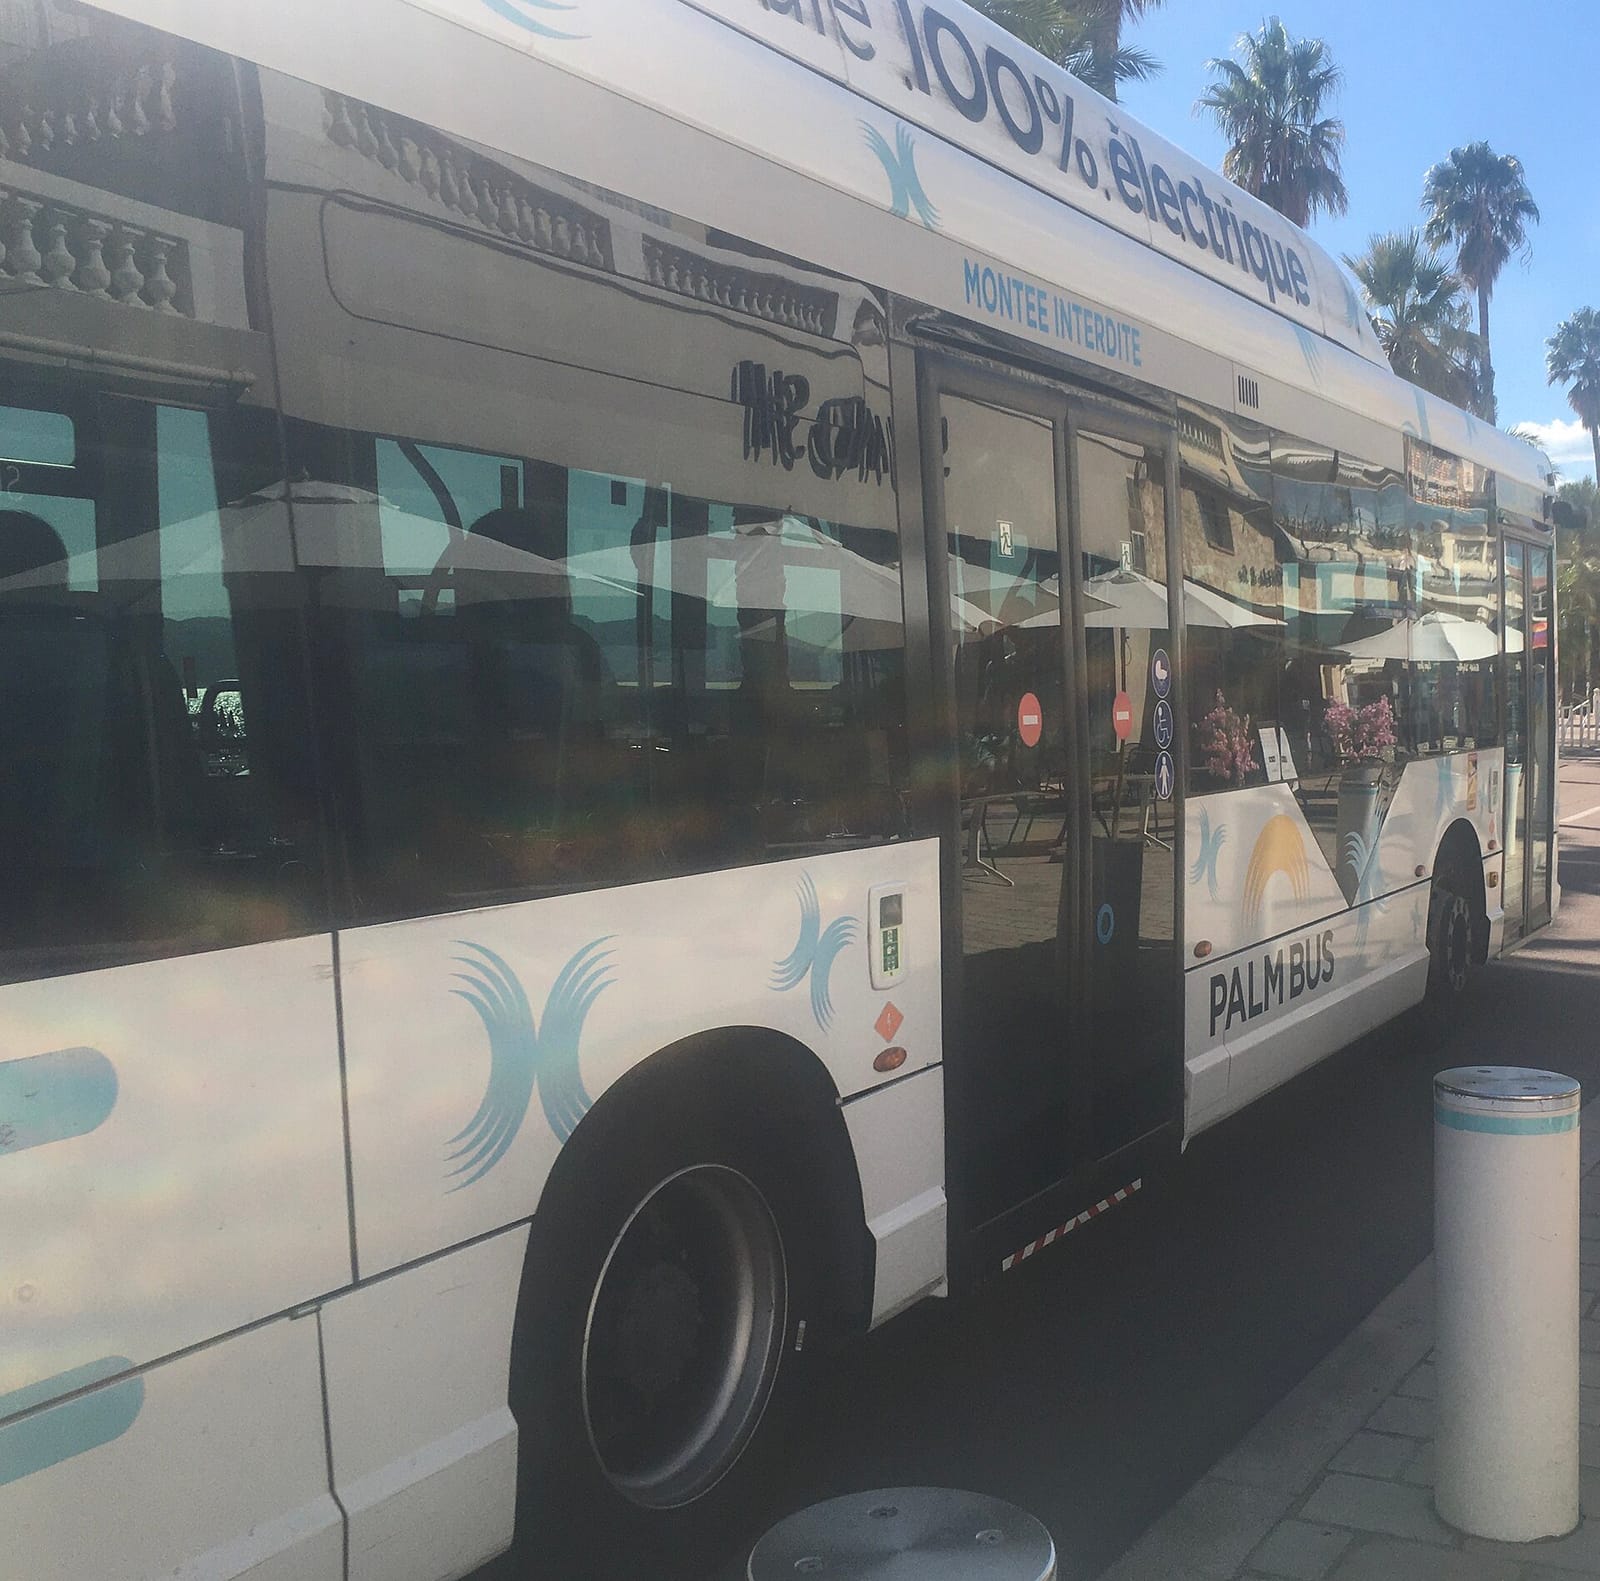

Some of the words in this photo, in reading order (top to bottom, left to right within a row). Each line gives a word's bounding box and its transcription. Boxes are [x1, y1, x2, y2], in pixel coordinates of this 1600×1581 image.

[897, 0, 1099, 190] 100%
[1106, 117, 1311, 307] électrique
[963, 258, 1050, 334] MONTEE
[1053, 295, 1142, 367] INTERDITE
[1209, 949, 1284, 1037] PALM
[1289, 929, 1335, 1000] BUS
